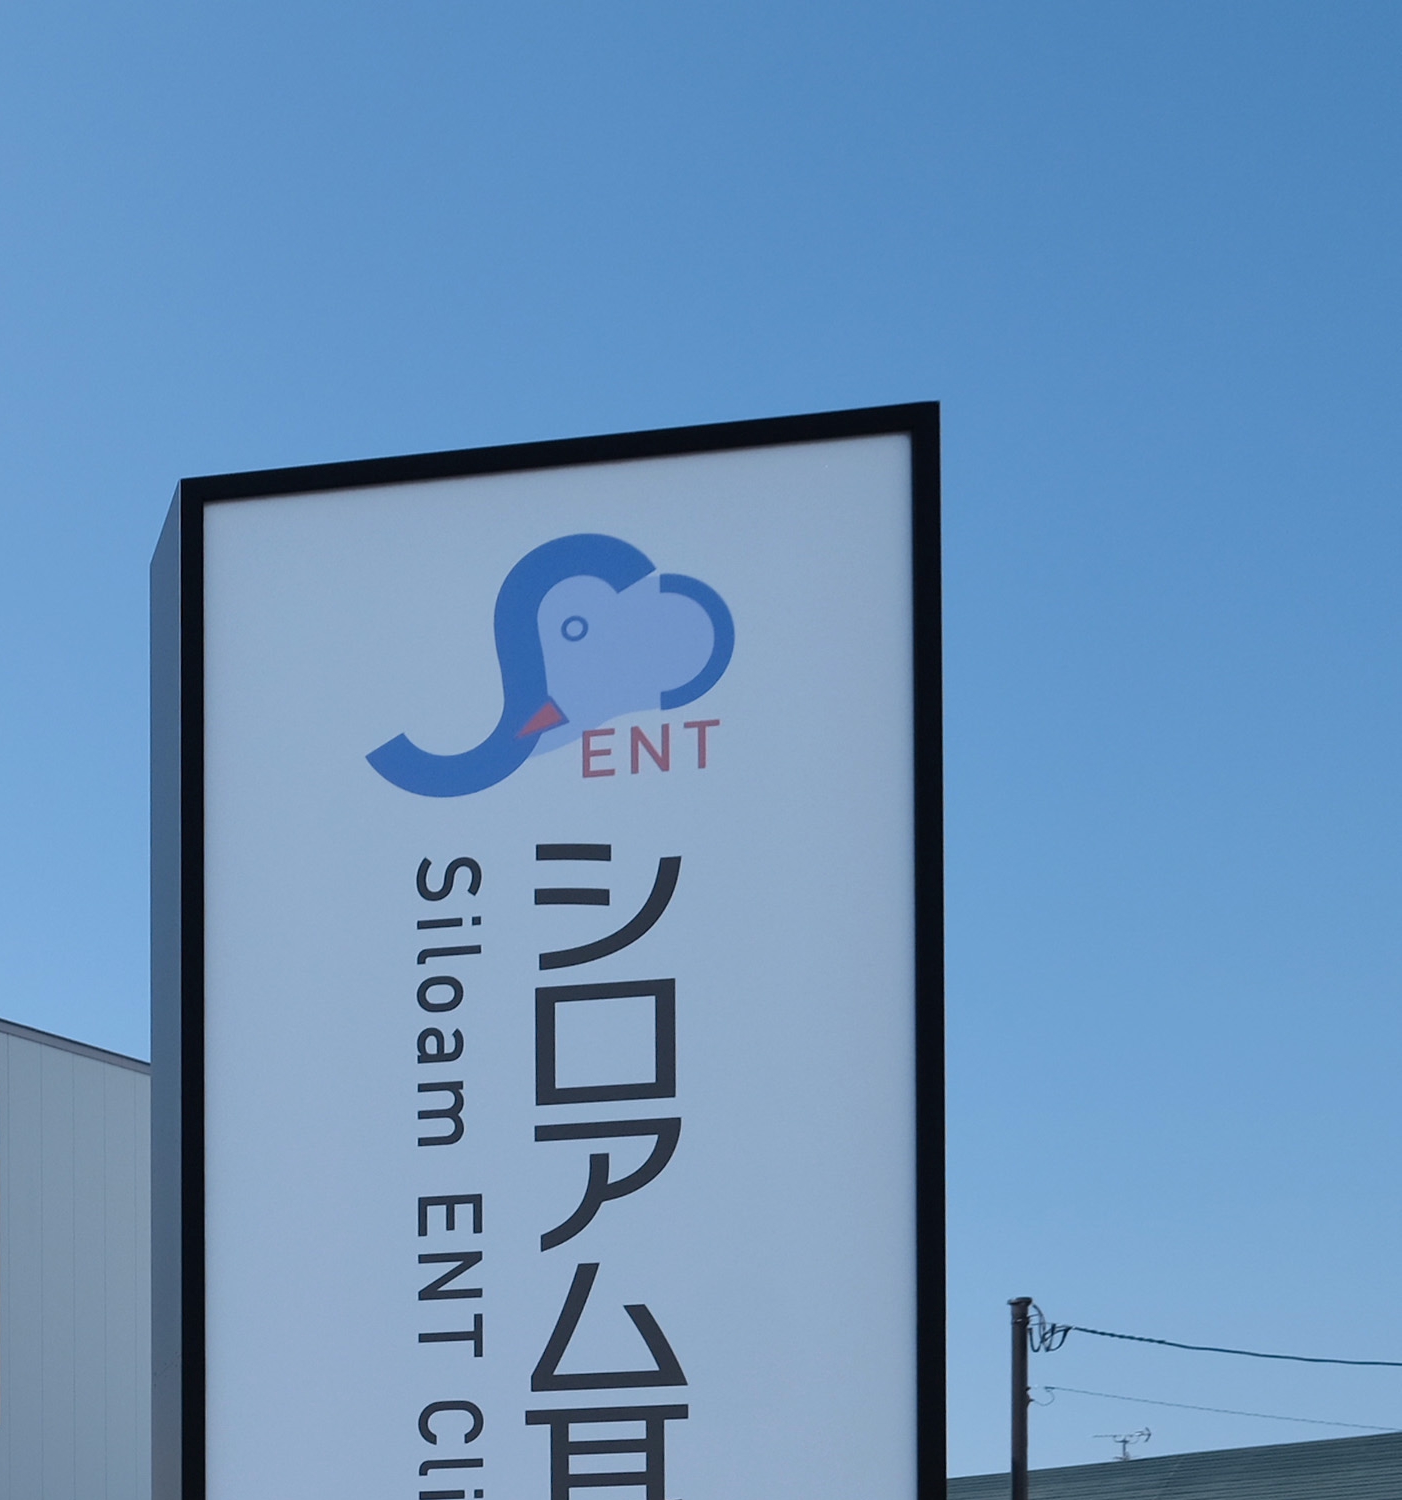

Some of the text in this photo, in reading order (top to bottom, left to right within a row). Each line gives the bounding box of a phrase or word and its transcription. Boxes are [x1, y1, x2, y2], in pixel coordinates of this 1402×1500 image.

[582, 719, 721, 778] ENT
[416, 856, 482, 1147] Siloam
[417, 1193, 483, 1358] ENT
